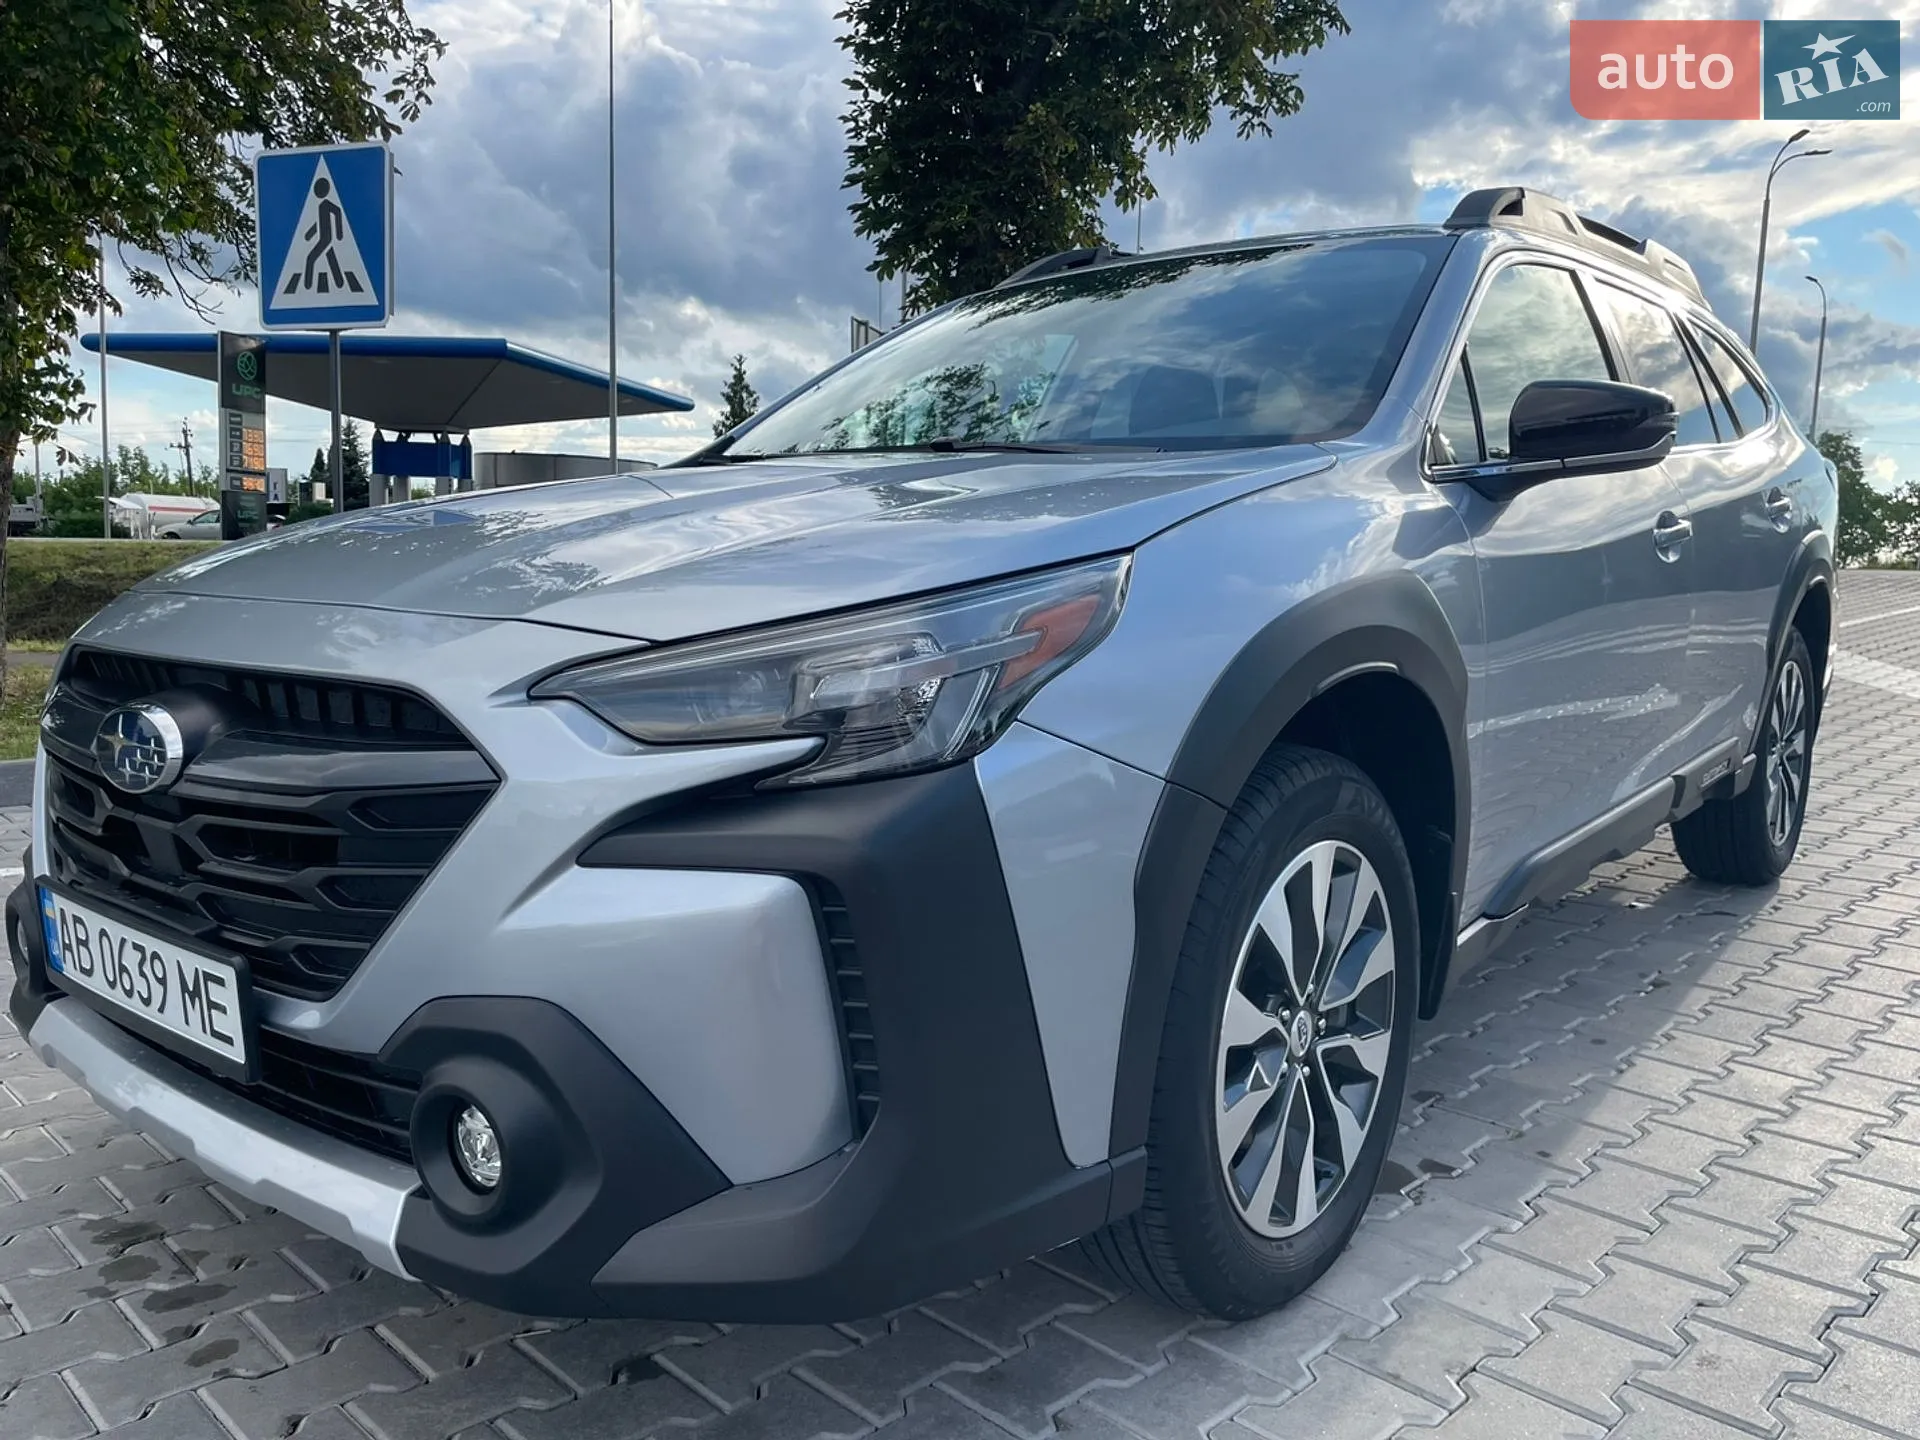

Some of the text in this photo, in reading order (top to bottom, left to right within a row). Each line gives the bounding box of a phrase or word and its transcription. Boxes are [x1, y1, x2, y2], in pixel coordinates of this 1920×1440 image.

[60, 908, 235, 1047] AB 0639 ME
